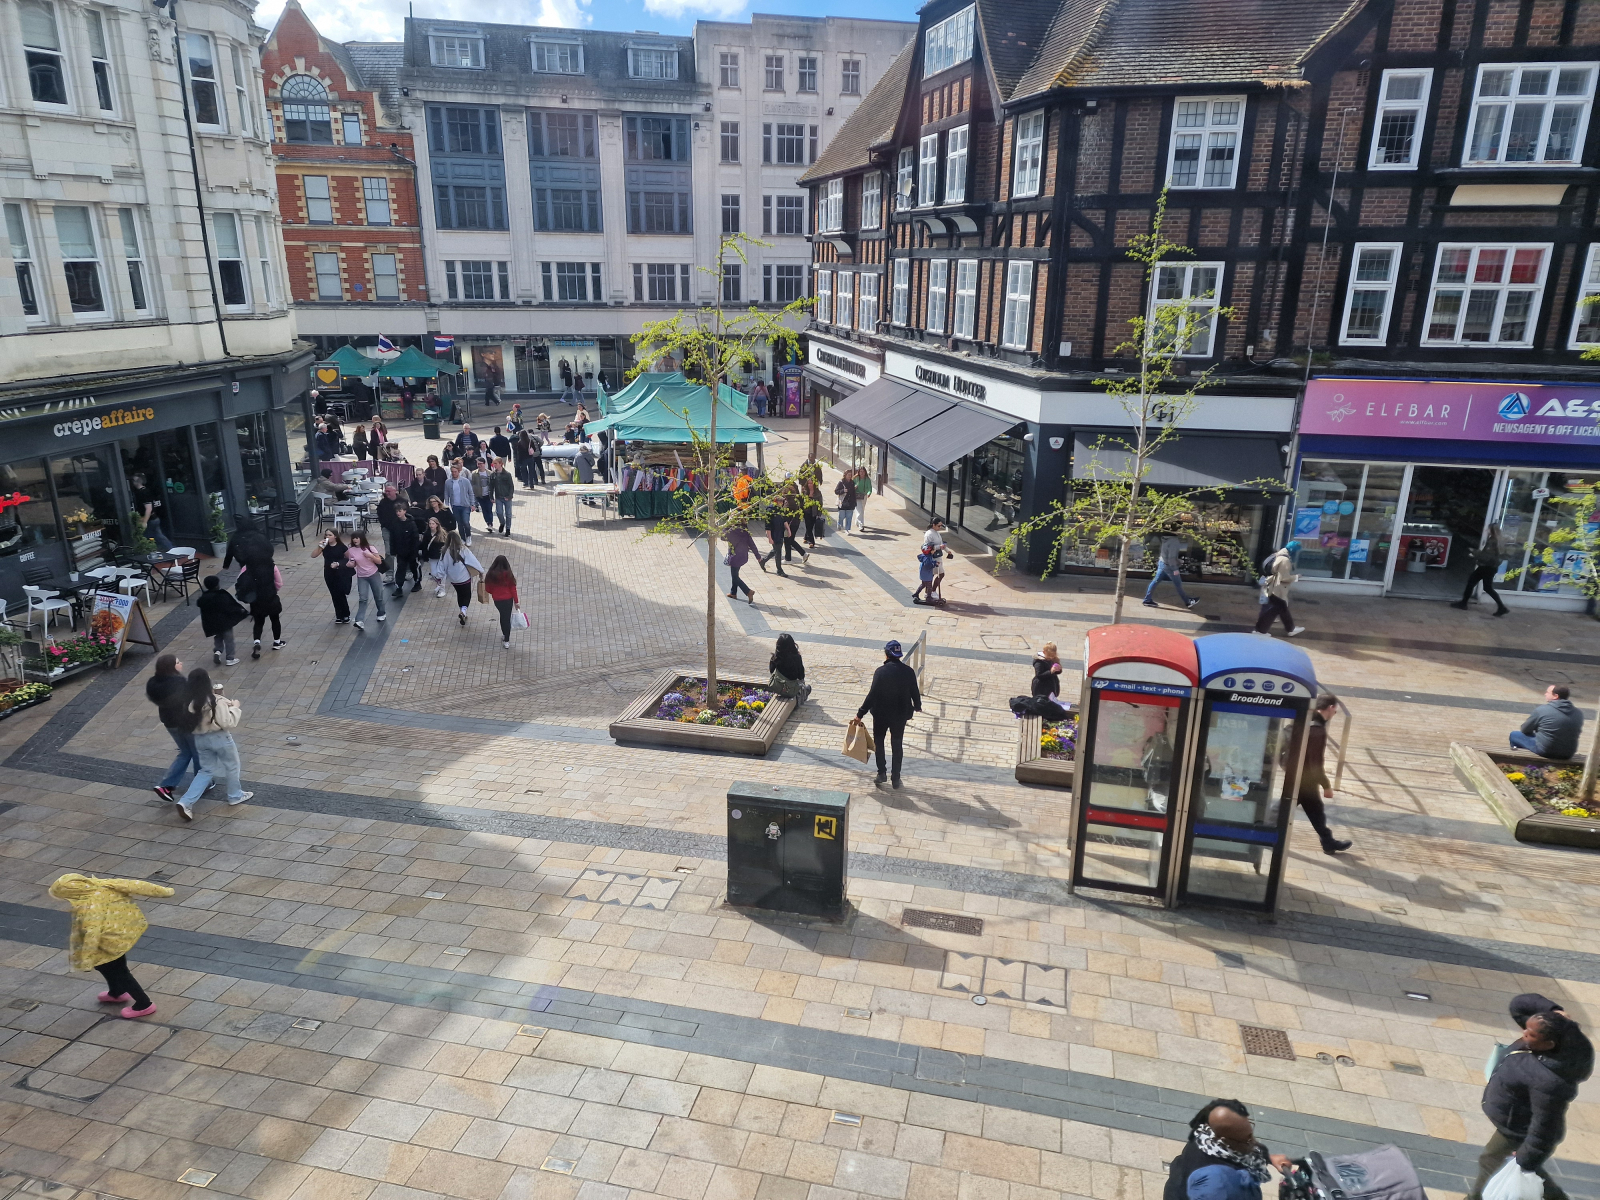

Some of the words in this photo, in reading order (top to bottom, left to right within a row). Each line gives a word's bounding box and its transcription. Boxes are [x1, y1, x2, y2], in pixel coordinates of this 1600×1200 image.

[915, 364, 950, 392] CHISHOLM
[953, 374, 987, 403] HUNTER
[1366, 402, 1451, 419] ELFBAR
[1493, 422, 1548, 434] NEWSAGENT
[1547, 424, 1555, 435] &
[1556, 425, 1574, 435] OFF
[20, 551, 35, 562] COFFEE
[1231, 693, 1284, 706] Broadband
